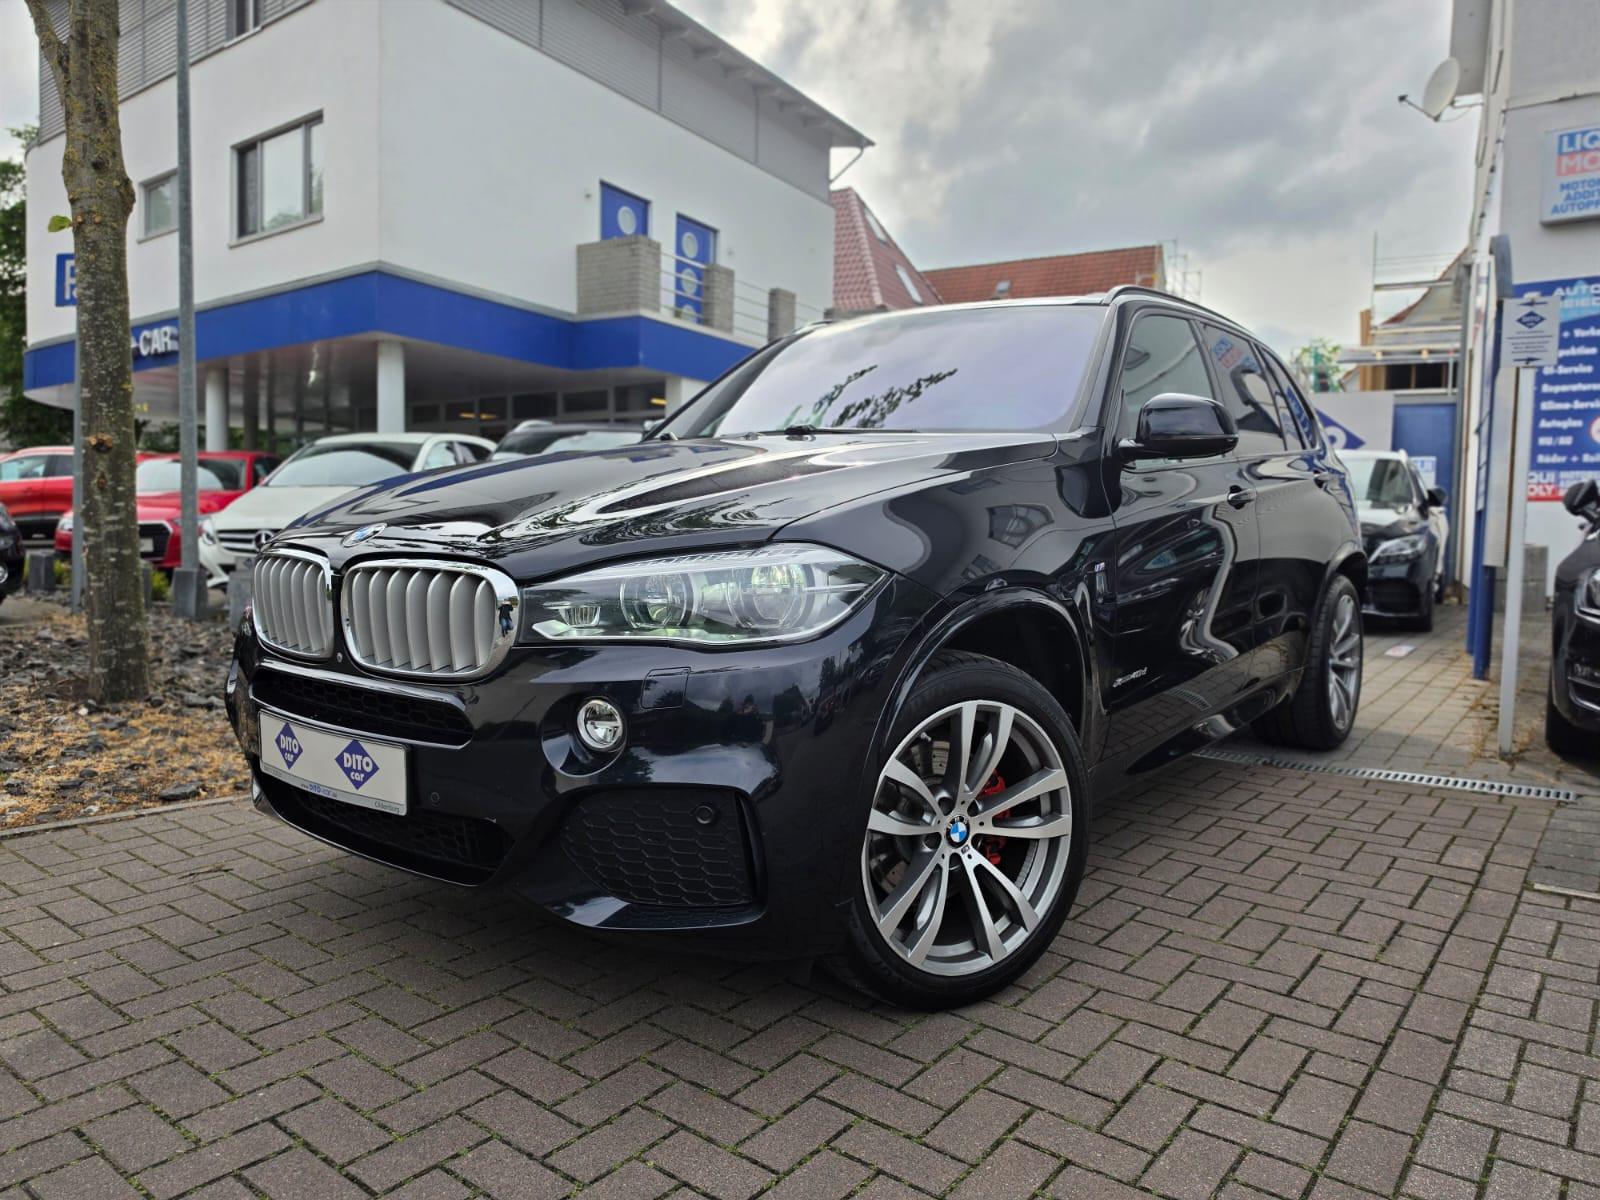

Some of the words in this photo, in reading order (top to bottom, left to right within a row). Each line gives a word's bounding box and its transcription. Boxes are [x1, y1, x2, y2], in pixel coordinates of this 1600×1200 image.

[280, 734, 300, 754] DITO
[284, 752, 294, 762] car
[343, 752, 373, 773] DITO
[350, 772, 365, 782] car
